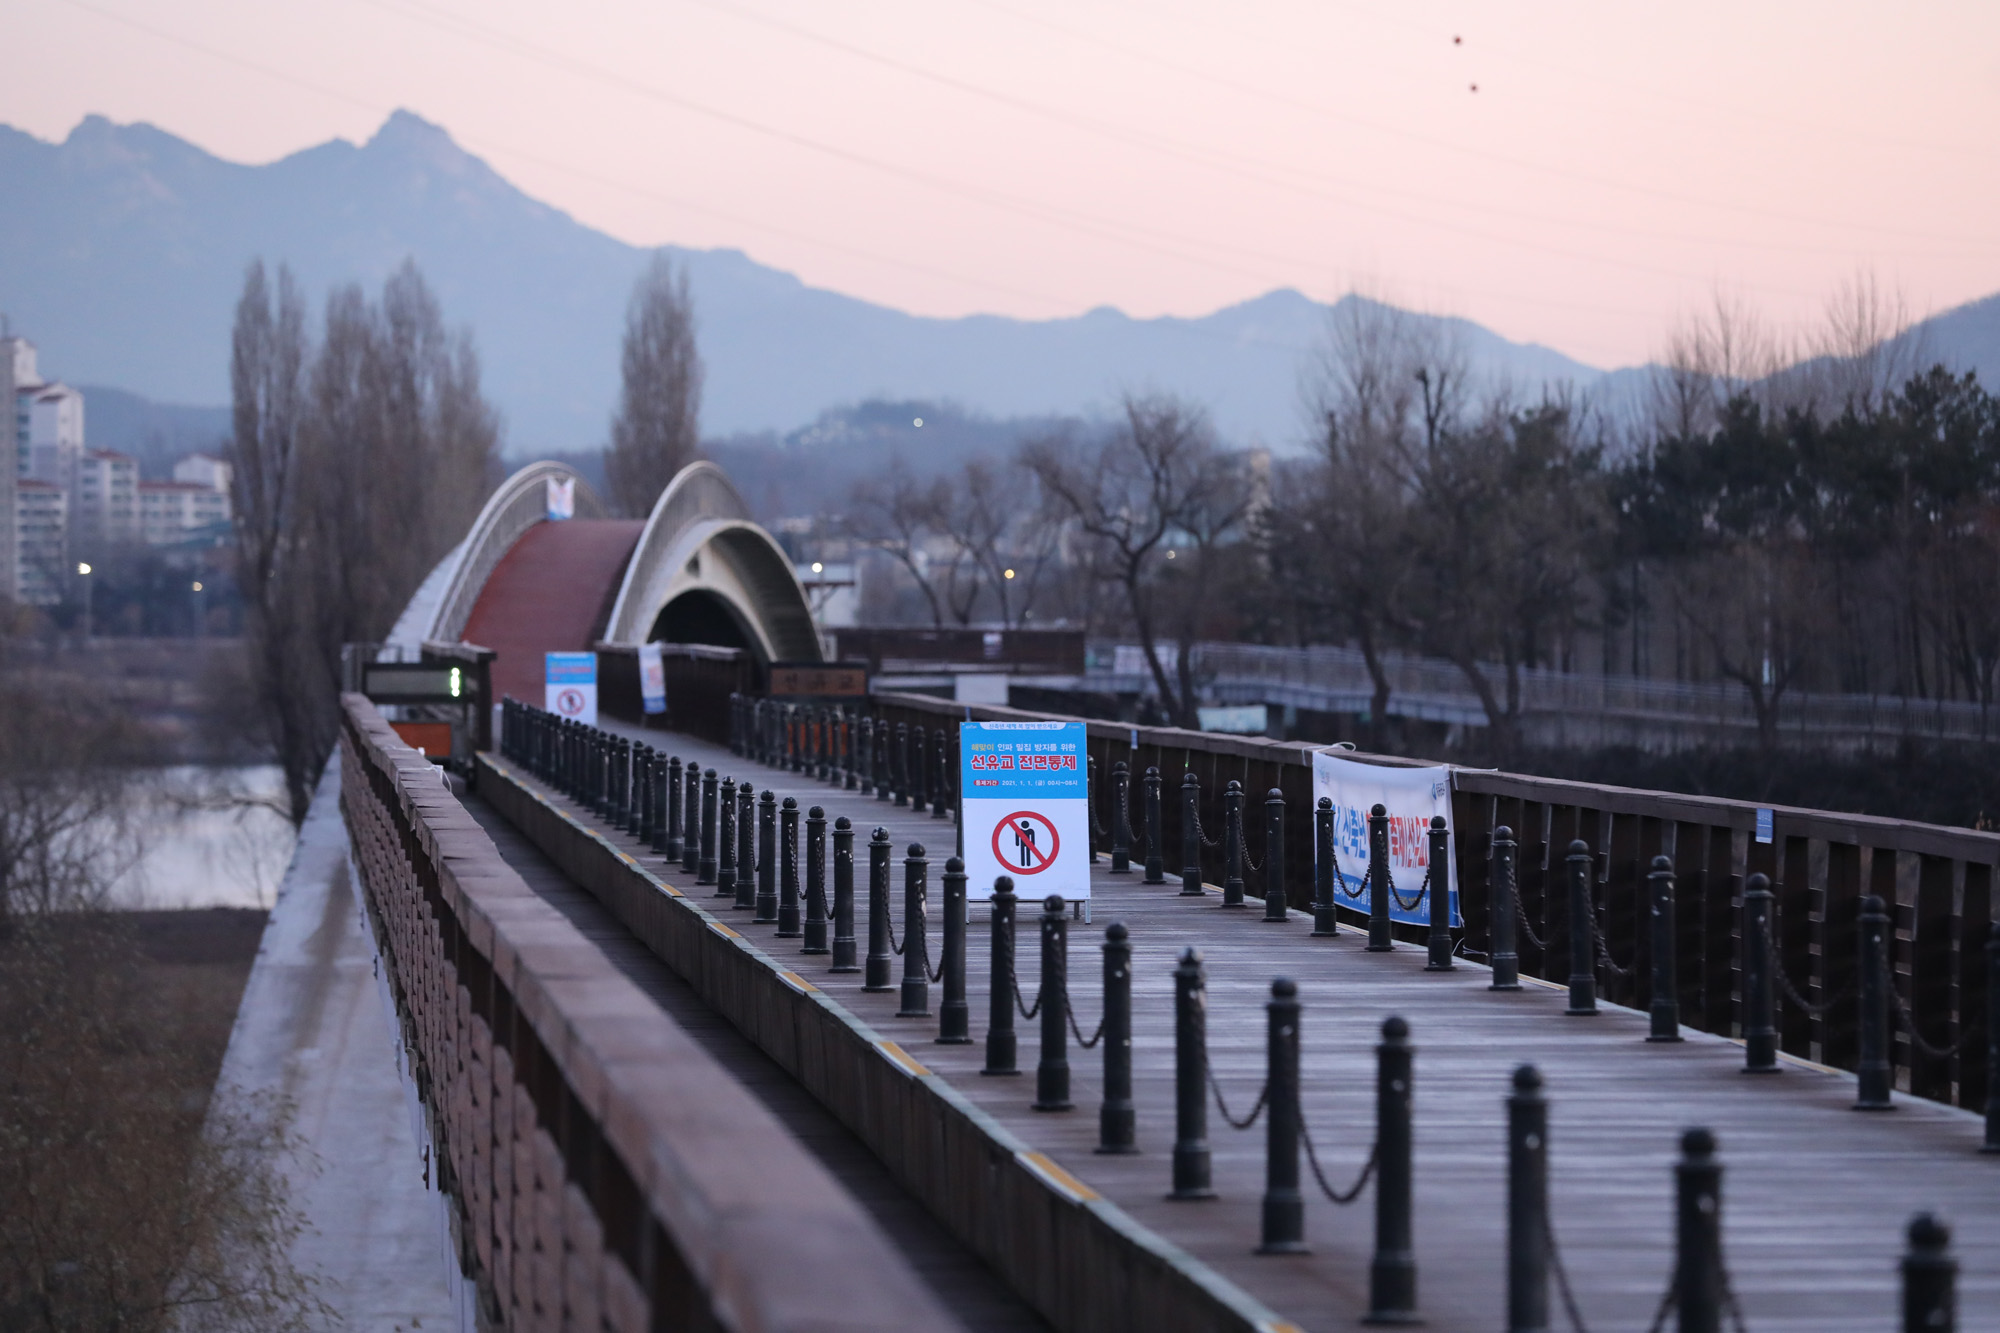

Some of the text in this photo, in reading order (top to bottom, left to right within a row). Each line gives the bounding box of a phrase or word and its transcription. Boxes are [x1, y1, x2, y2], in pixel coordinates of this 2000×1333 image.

[971, 743, 1076, 751] 해맞이 인파 밀집 방지를 위한
[971, 754, 1077, 771] 선유교 전면통제
